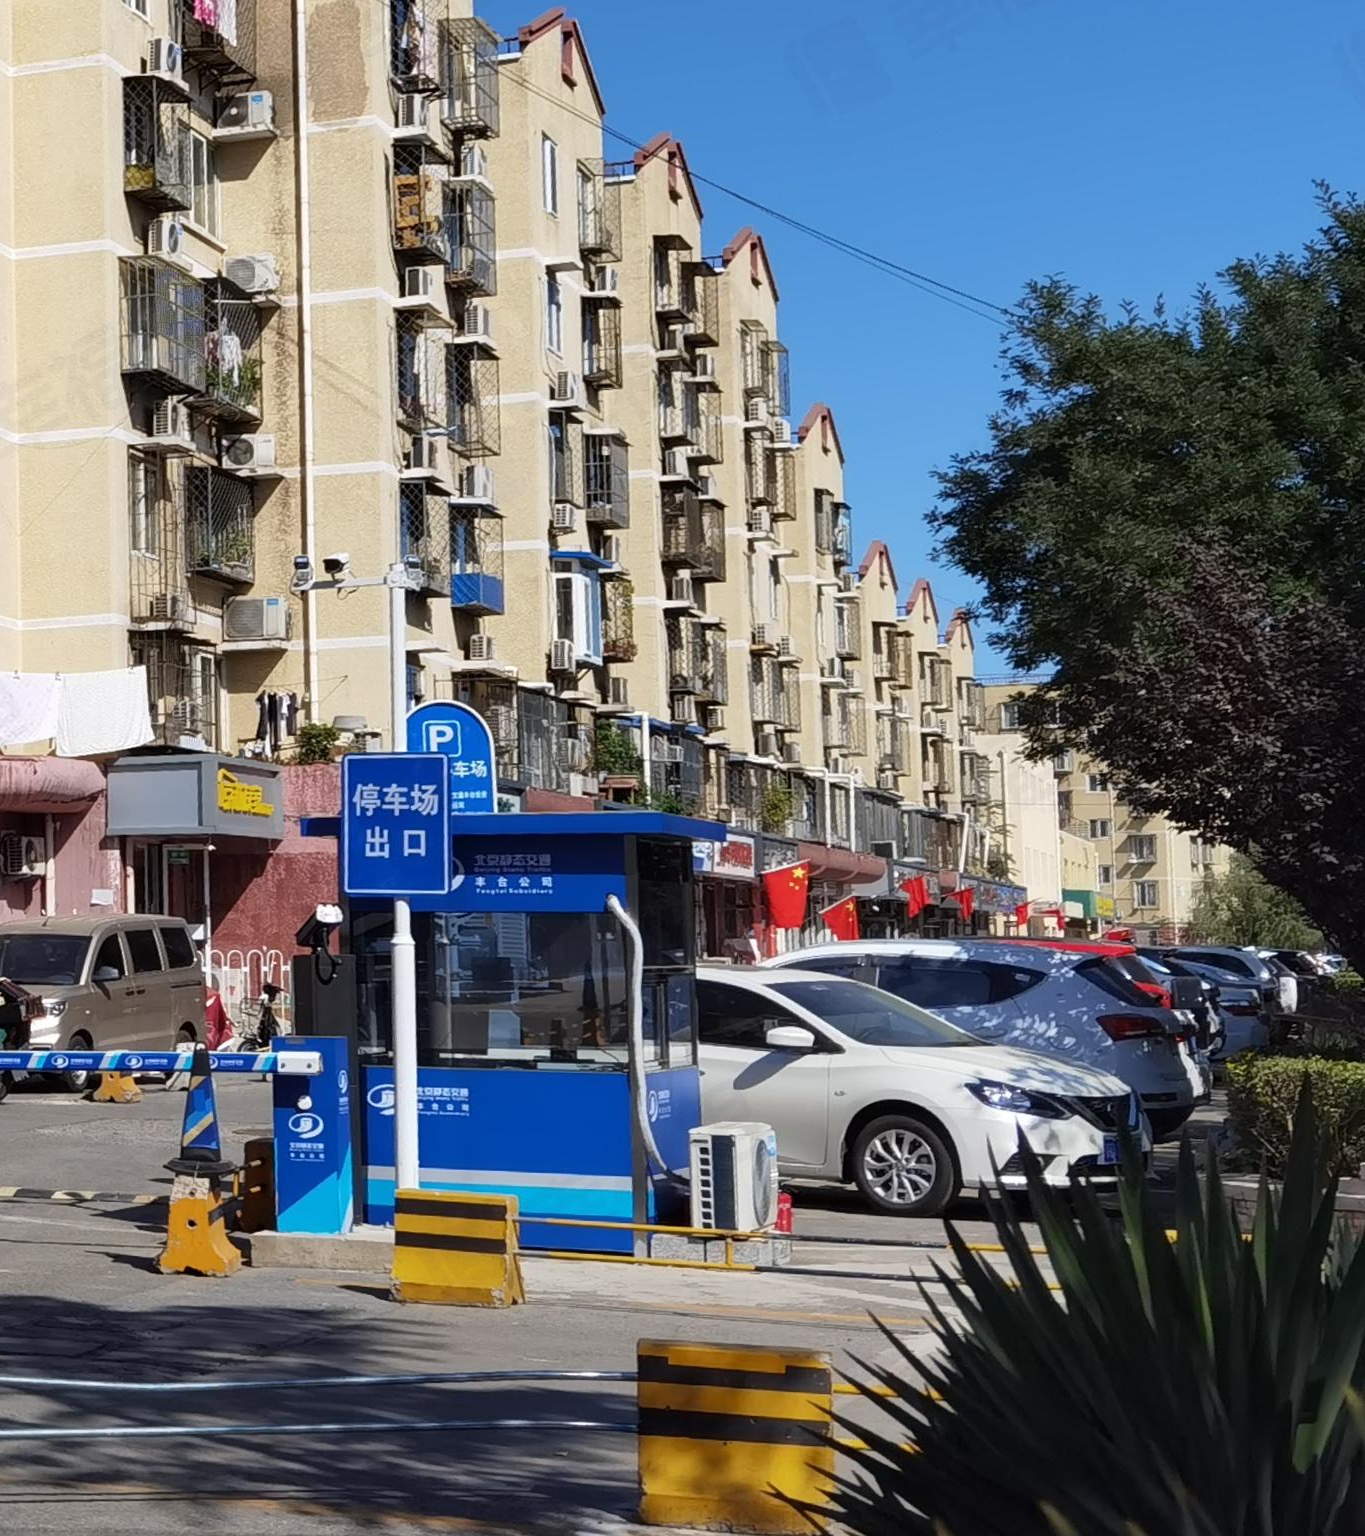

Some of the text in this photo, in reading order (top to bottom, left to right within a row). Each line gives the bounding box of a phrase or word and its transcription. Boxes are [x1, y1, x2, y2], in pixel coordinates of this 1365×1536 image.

[429, 725, 454, 752] P
[451, 760, 487, 778] 车场
[352, 783, 439, 817] 停车场
[364, 826, 426, 859] 出口
[475, 876, 553, 888] 丰台公司
